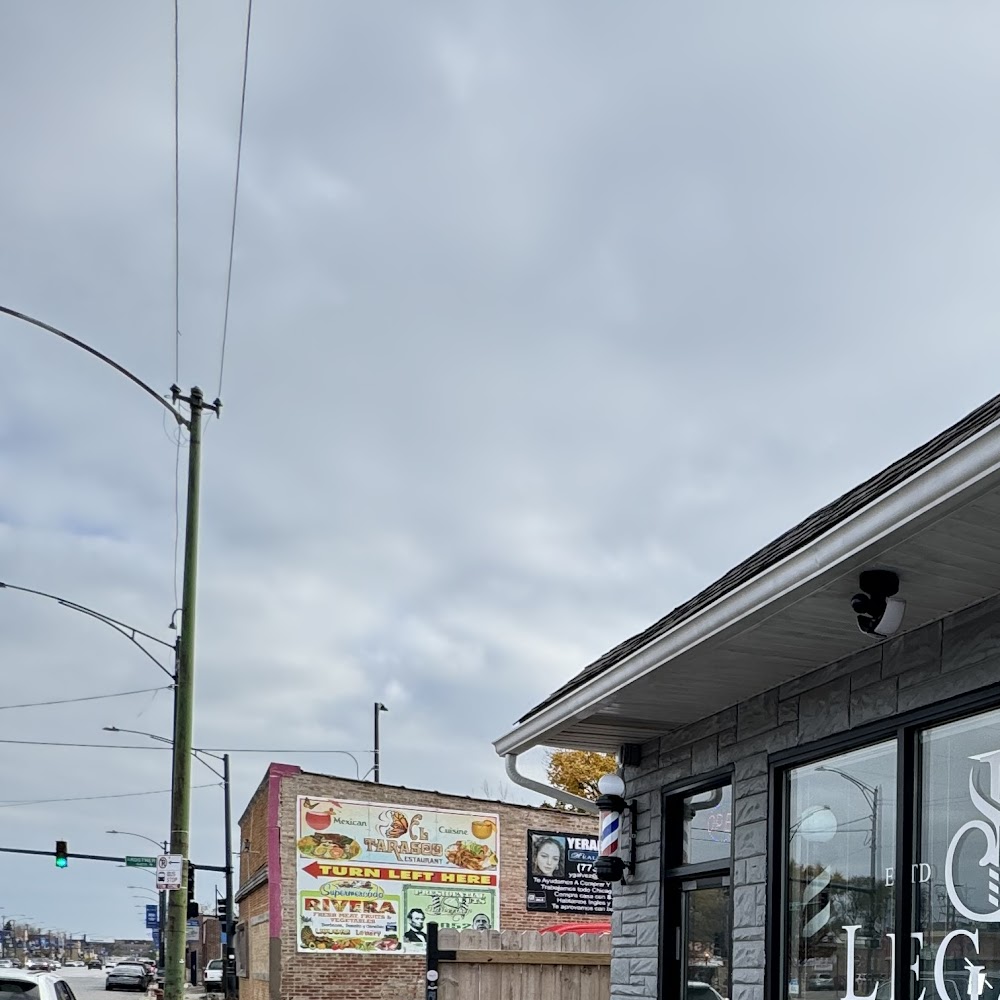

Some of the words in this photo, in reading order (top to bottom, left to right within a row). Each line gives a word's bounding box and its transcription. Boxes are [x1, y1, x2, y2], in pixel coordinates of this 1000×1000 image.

[333, 817, 367, 827] Mexican
[438, 826, 469, 836] Cuisine
[363, 838, 444, 857] TARASCO
[567, 837, 600, 851] YERA
[319, 865, 380, 879] TURN
[388, 869, 434, 881] LEFT
[441, 873, 491, 885] HERE
[885, 863, 931, 887] ETD
[321, 882, 384, 898] Supermercado
[305, 898, 396, 914] RIVERA
